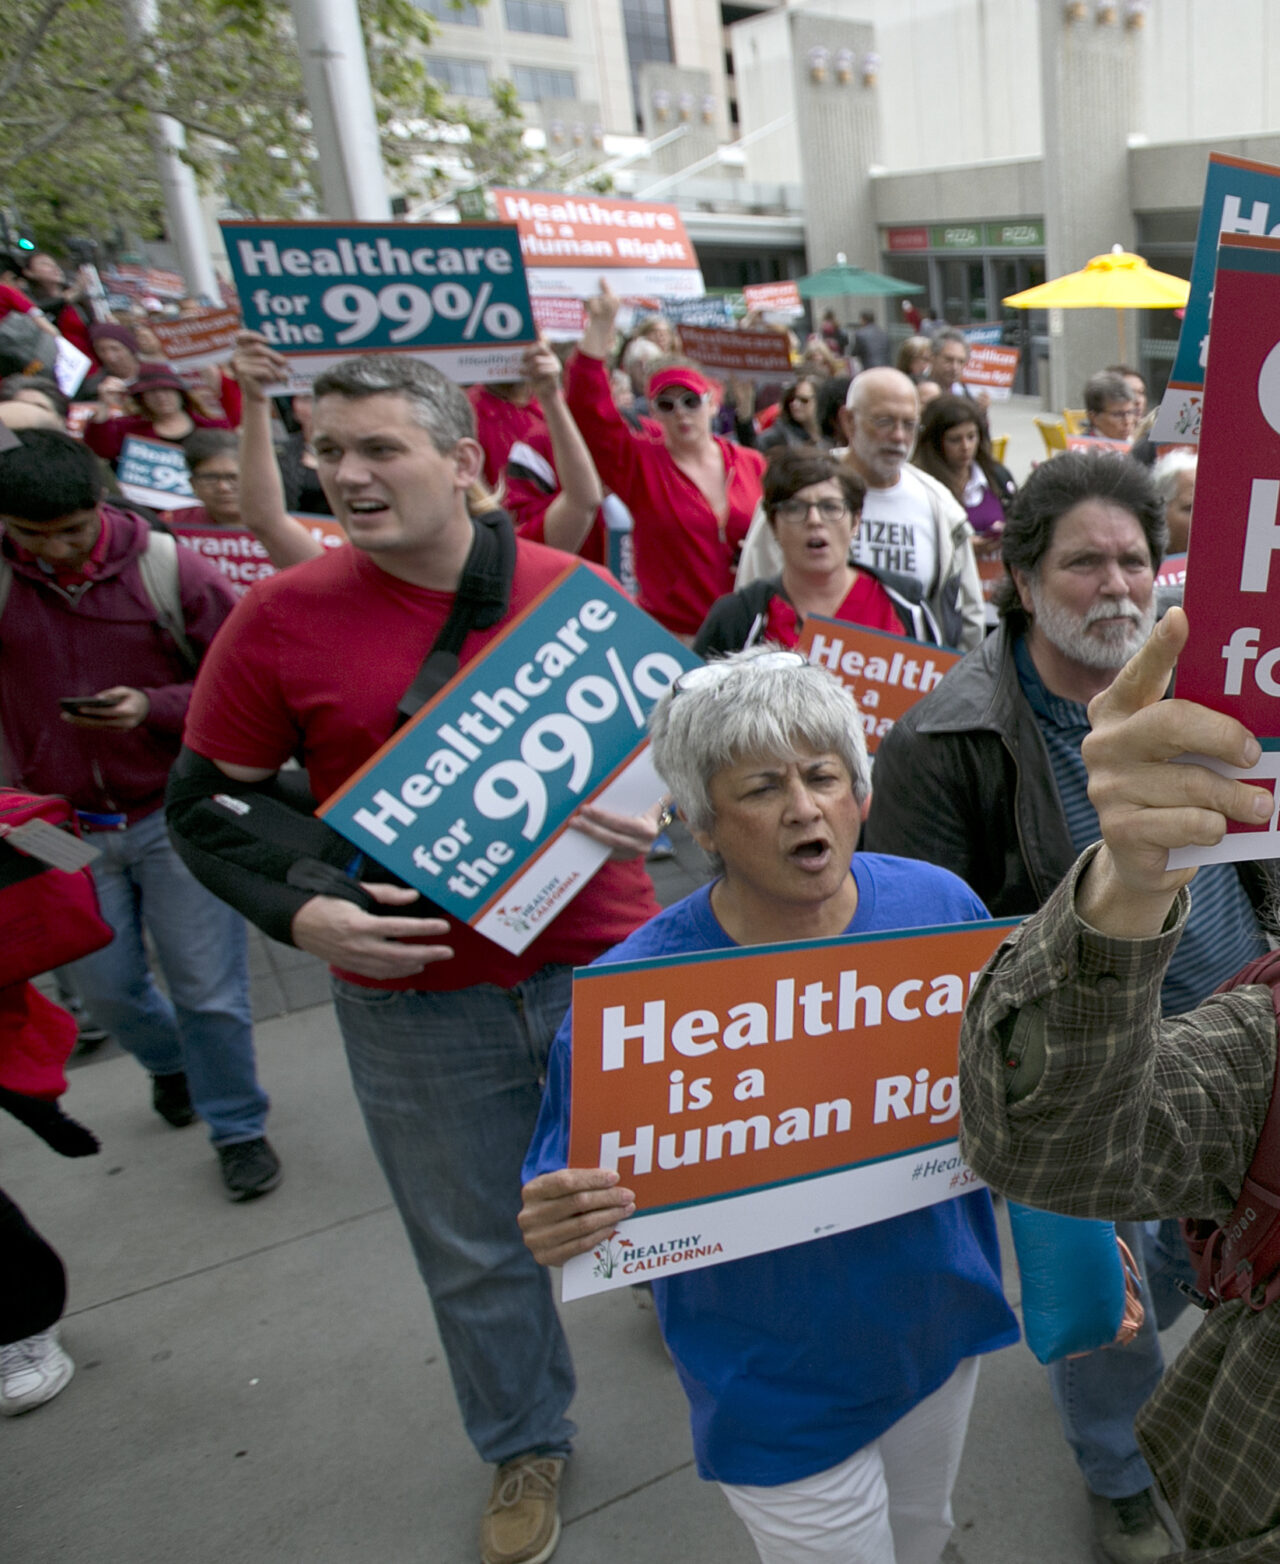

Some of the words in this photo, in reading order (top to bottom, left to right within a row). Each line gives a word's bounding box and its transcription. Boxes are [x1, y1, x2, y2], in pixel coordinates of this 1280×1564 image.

[504, 196, 676, 231] Healthcare
[238, 238, 513, 277] Healthcare
[617, 238, 687, 264] Right
[253, 289, 310, 316] for
[322, 282, 524, 345] 99%
[260, 317, 324, 345] the
[870, 547, 916, 572] THE
[808, 634, 945, 692] Health
[352, 598, 618, 846] Healthcare
[473, 647, 685, 841] 99%
[413, 818, 473, 876] for
[447, 840, 516, 899] the
[522, 877, 560, 917] HEALTHY
[531, 872, 580, 922] CALIFORNIA
[602, 969, 978, 1072] Healthca
[669, 1070, 712, 1115] is
[733, 1068, 765, 1101] a
[599, 1097, 852, 1177] Human
[874, 1068, 960, 1125] Rig
[622, 1242, 724, 1275] CALIFORNIA
[623, 1234, 702, 1262] HEALTHY
